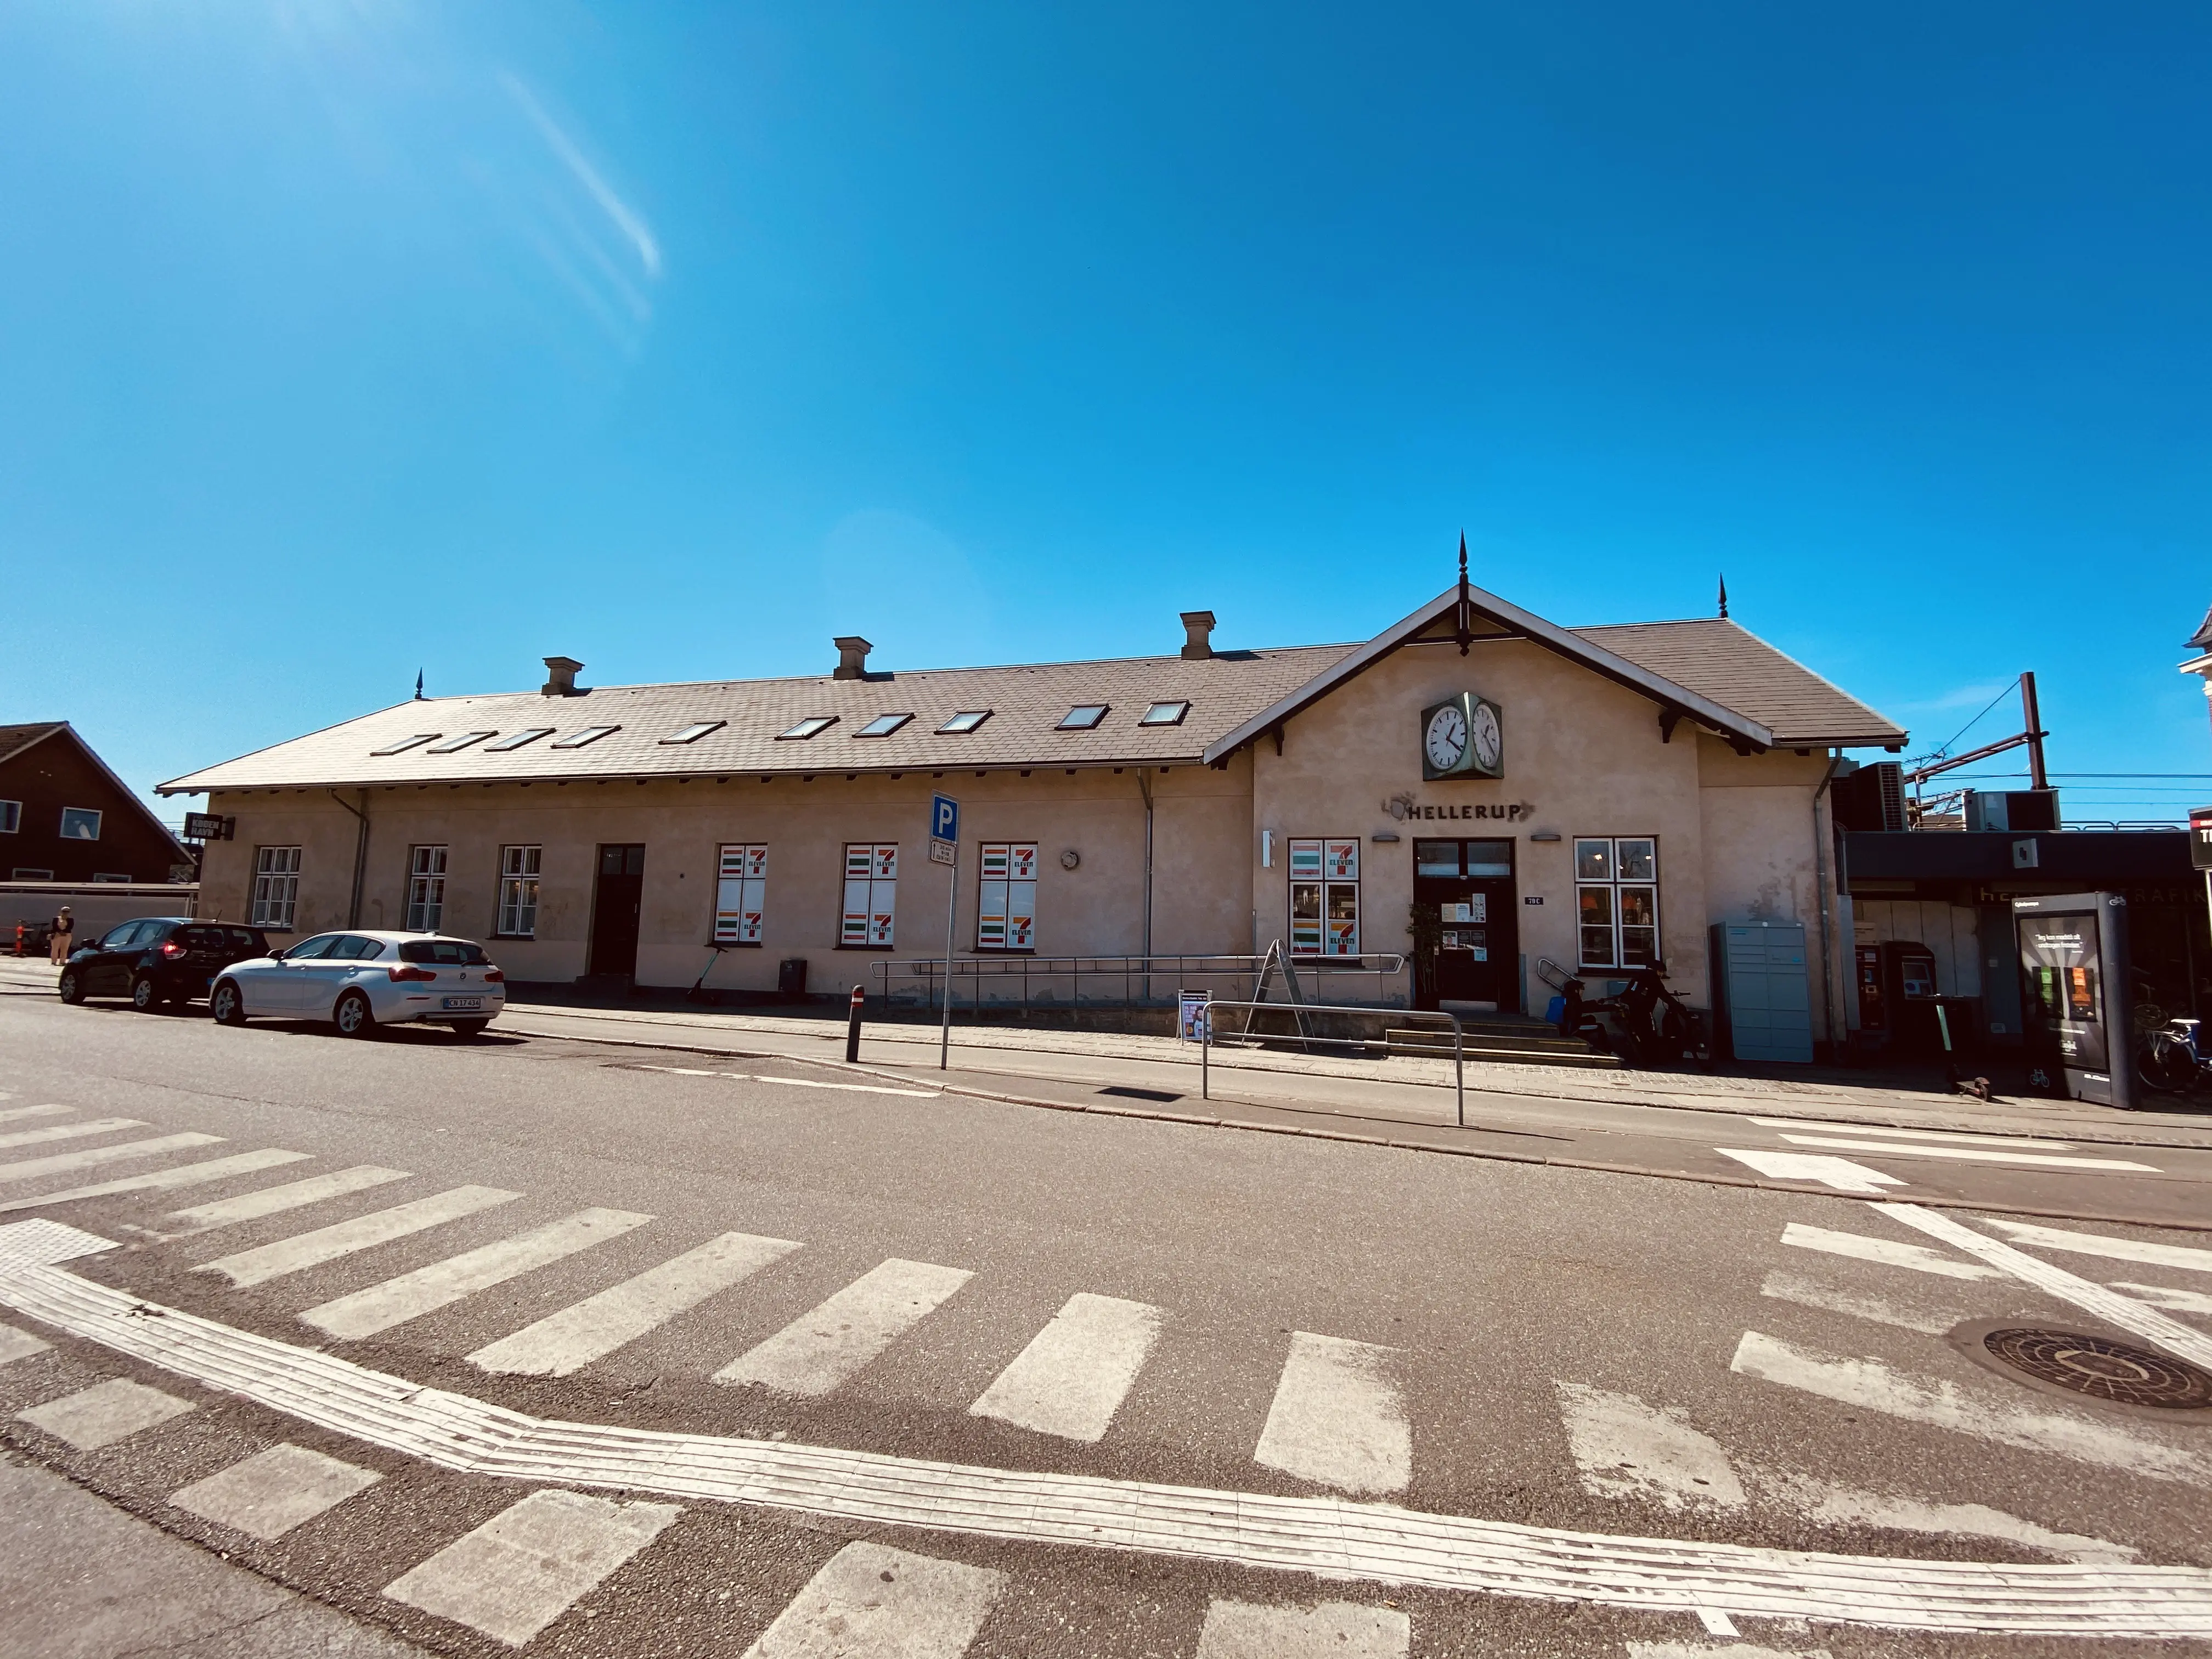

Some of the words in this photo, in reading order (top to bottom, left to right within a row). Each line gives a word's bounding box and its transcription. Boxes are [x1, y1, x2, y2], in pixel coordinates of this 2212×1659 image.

[939, 802, 953, 833] P
[1408, 805, 1520, 820] HELLERUP
[751, 850, 765, 874] 7
[878, 849, 894, 874] 7
[1015, 849, 1033, 875] 7
[1330, 845, 1352, 874] 7
[746, 913, 761, 937] 7
[874, 915, 891, 940] 7
[1013, 917, 1031, 944] 7
[1331, 923, 1354, 953] 7
